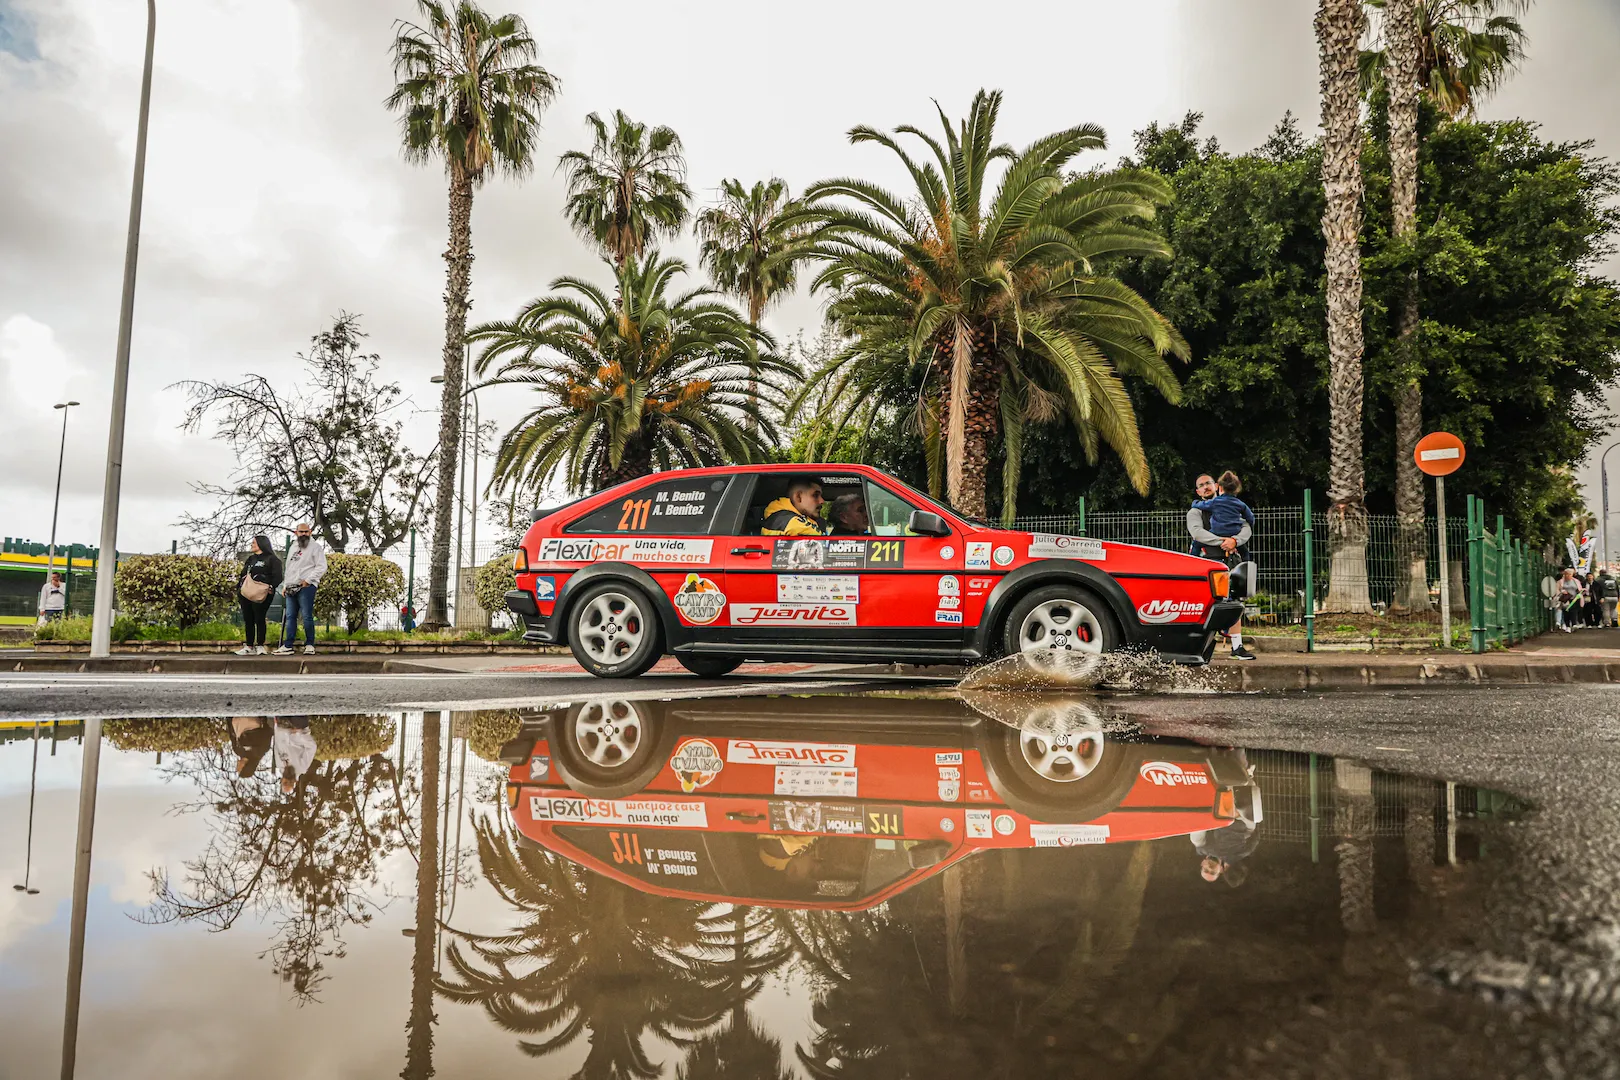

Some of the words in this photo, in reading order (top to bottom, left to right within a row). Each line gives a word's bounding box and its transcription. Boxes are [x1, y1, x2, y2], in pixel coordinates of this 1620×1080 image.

[655, 491, 669, 502] M.
[672, 490, 706, 502] Benito
[617, 499, 652, 530] 211
[652, 504, 663, 516] A.
[665, 503, 705, 516] Benítez
[542, 540, 630, 560] Flexicar
[635, 540, 658, 549] Una
[660, 540, 686, 550] vida,
[828, 543, 865, 553] NORTE
[632, 552, 678, 561] muchos
[680, 552, 706, 562] cars
[870, 542, 900, 562] 211
[969, 578, 992, 588] GT
[675, 593, 726, 606] CAYRO
[1147, 600, 1204, 614] Molina
[736, 606, 850, 624] Juanito
[937, 614, 960, 622] FRAN
